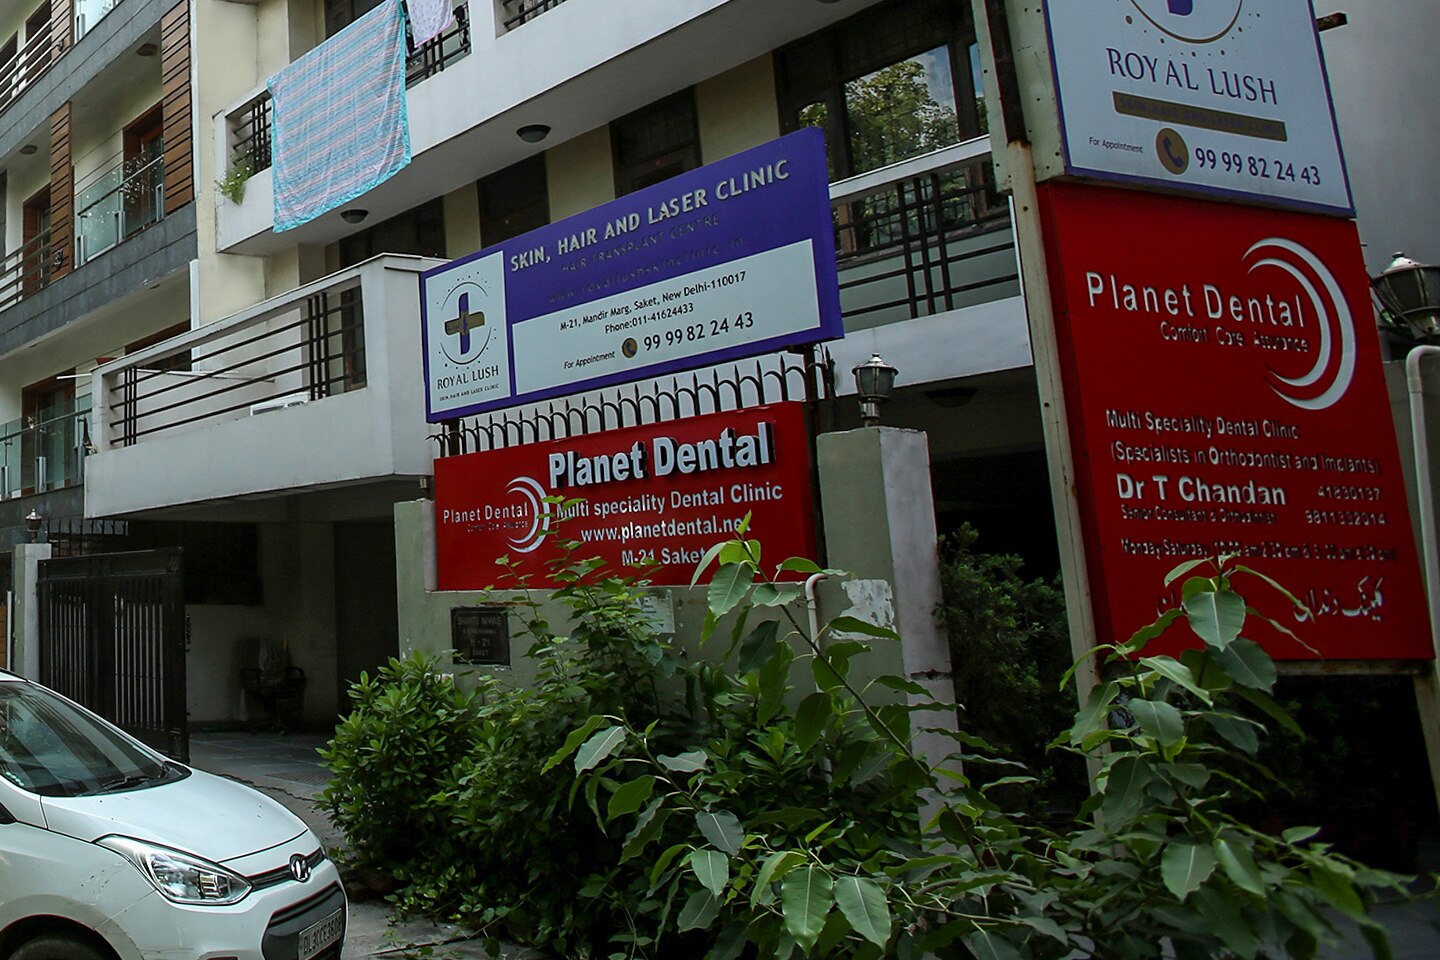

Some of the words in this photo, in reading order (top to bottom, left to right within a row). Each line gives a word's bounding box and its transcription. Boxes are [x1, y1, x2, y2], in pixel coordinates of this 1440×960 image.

[1106, 48, 1199, 91] ROYAL
[1207, 68, 1278, 106] LUSH
[1089, 136, 1101, 147] For
[1102, 139, 1144, 154] Appointment
[1195, 147, 1217, 170] 99
[1222, 153, 1243, 173] 99
[1248, 156, 1270, 178] 82
[1274, 161, 1296, 182] 24
[1301, 165, 1321, 186] 43
[510, 246, 551, 272] SKIN,
[558, 228, 598, 255] HAIR
[604, 213, 640, 240] AND
[648, 188, 708, 224] LASER
[715, 160, 789, 200] CLINIC
[670, 214, 719, 239] CENTRE
[560, 318, 581, 331] M-21,
[582, 311, 609, 325] Mandir
[610, 304, 632, 318] Marg,
[634, 296, 660, 311] Saket,
[663, 289, 682, 303] New
[683, 270, 747, 297] Delhi-110017
[1085, 271, 1195, 317] Planet
[1203, 284, 1304, 328] Dental
[643, 333, 661, 351] 99
[665, 329, 683, 346] 99
[687, 323, 706, 341] 82
[710, 317, 729, 336] 24
[734, 311, 754, 329] 43
[1160, 321, 1209, 343] Comfort
[1215, 326, 1244, 347] Care
[564, 360, 575, 370] For
[576, 350, 616, 368] Appointment
[437, 373, 469, 390] ROYAL
[472, 365, 499, 381] LUSH
[1106, 409, 1141, 429] Multi
[1145, 411, 1212, 439] Speciality
[1216, 416, 1259, 436] Dental
[1263, 419, 1300, 439] Clinic
[549, 441, 645, 489] Planet
[653, 421, 773, 477] Dental
[1195, 448, 1206, 464] in
[1208, 446, 1291, 469] Orthodontist
[1295, 452, 1318, 471] and
[593, 495, 665, 518] speciality
[671, 486, 725, 509] Dental
[730, 482, 783, 504] Clinic
[1117, 473, 1145, 499] Dr
[1152, 475, 1168, 500] T
[1178, 476, 1286, 505] Chandan
[443, 508, 481, 524] Planet
[485, 501, 528, 520] Dental
[581, 515, 751, 543] www.planetdental.ne
